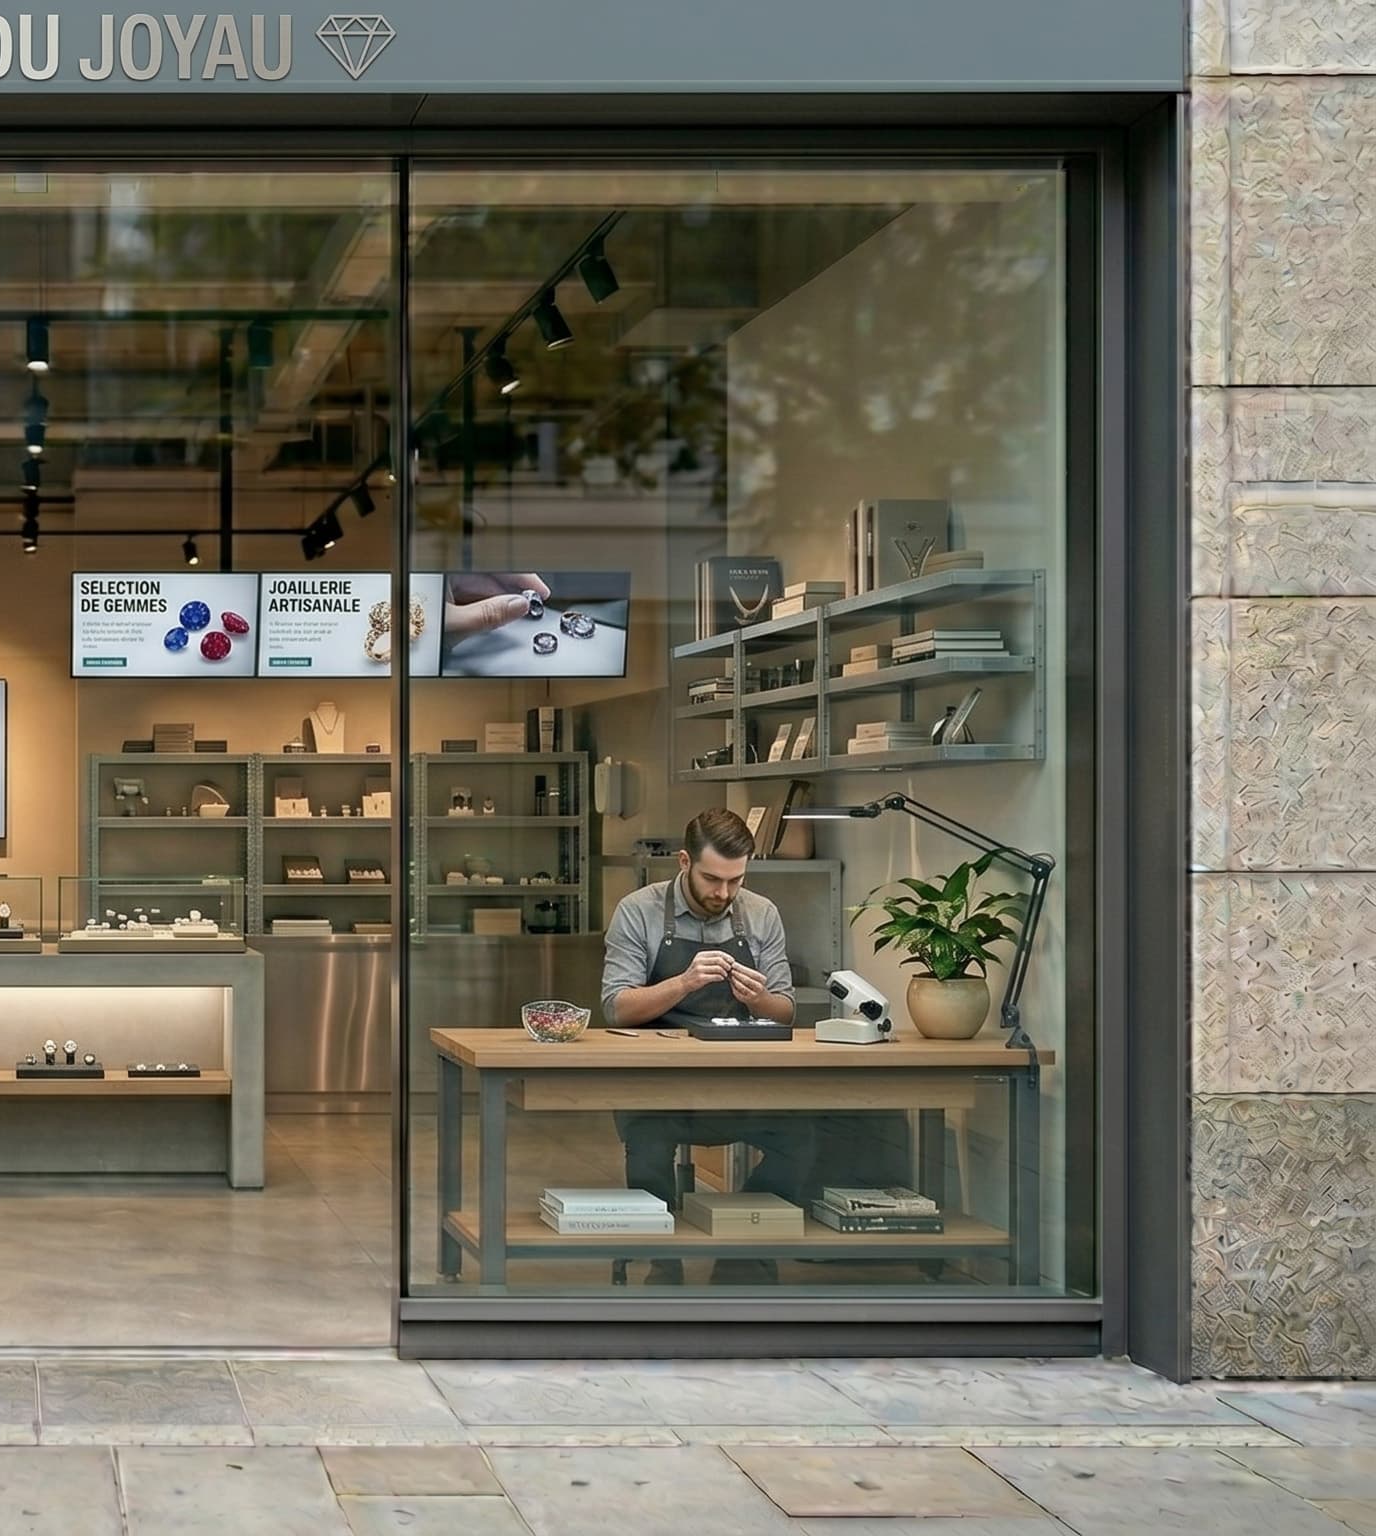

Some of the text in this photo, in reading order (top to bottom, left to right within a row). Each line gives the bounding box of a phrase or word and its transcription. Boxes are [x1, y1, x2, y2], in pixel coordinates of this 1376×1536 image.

[79, 14, 292, 80] JOYAU
[80, 580, 161, 595] SELECTION
[268, 580, 353, 595] JOAILLERIE
[80, 598, 168, 613] DE GEMMES
[268, 598, 361, 613] ARTISANALE
